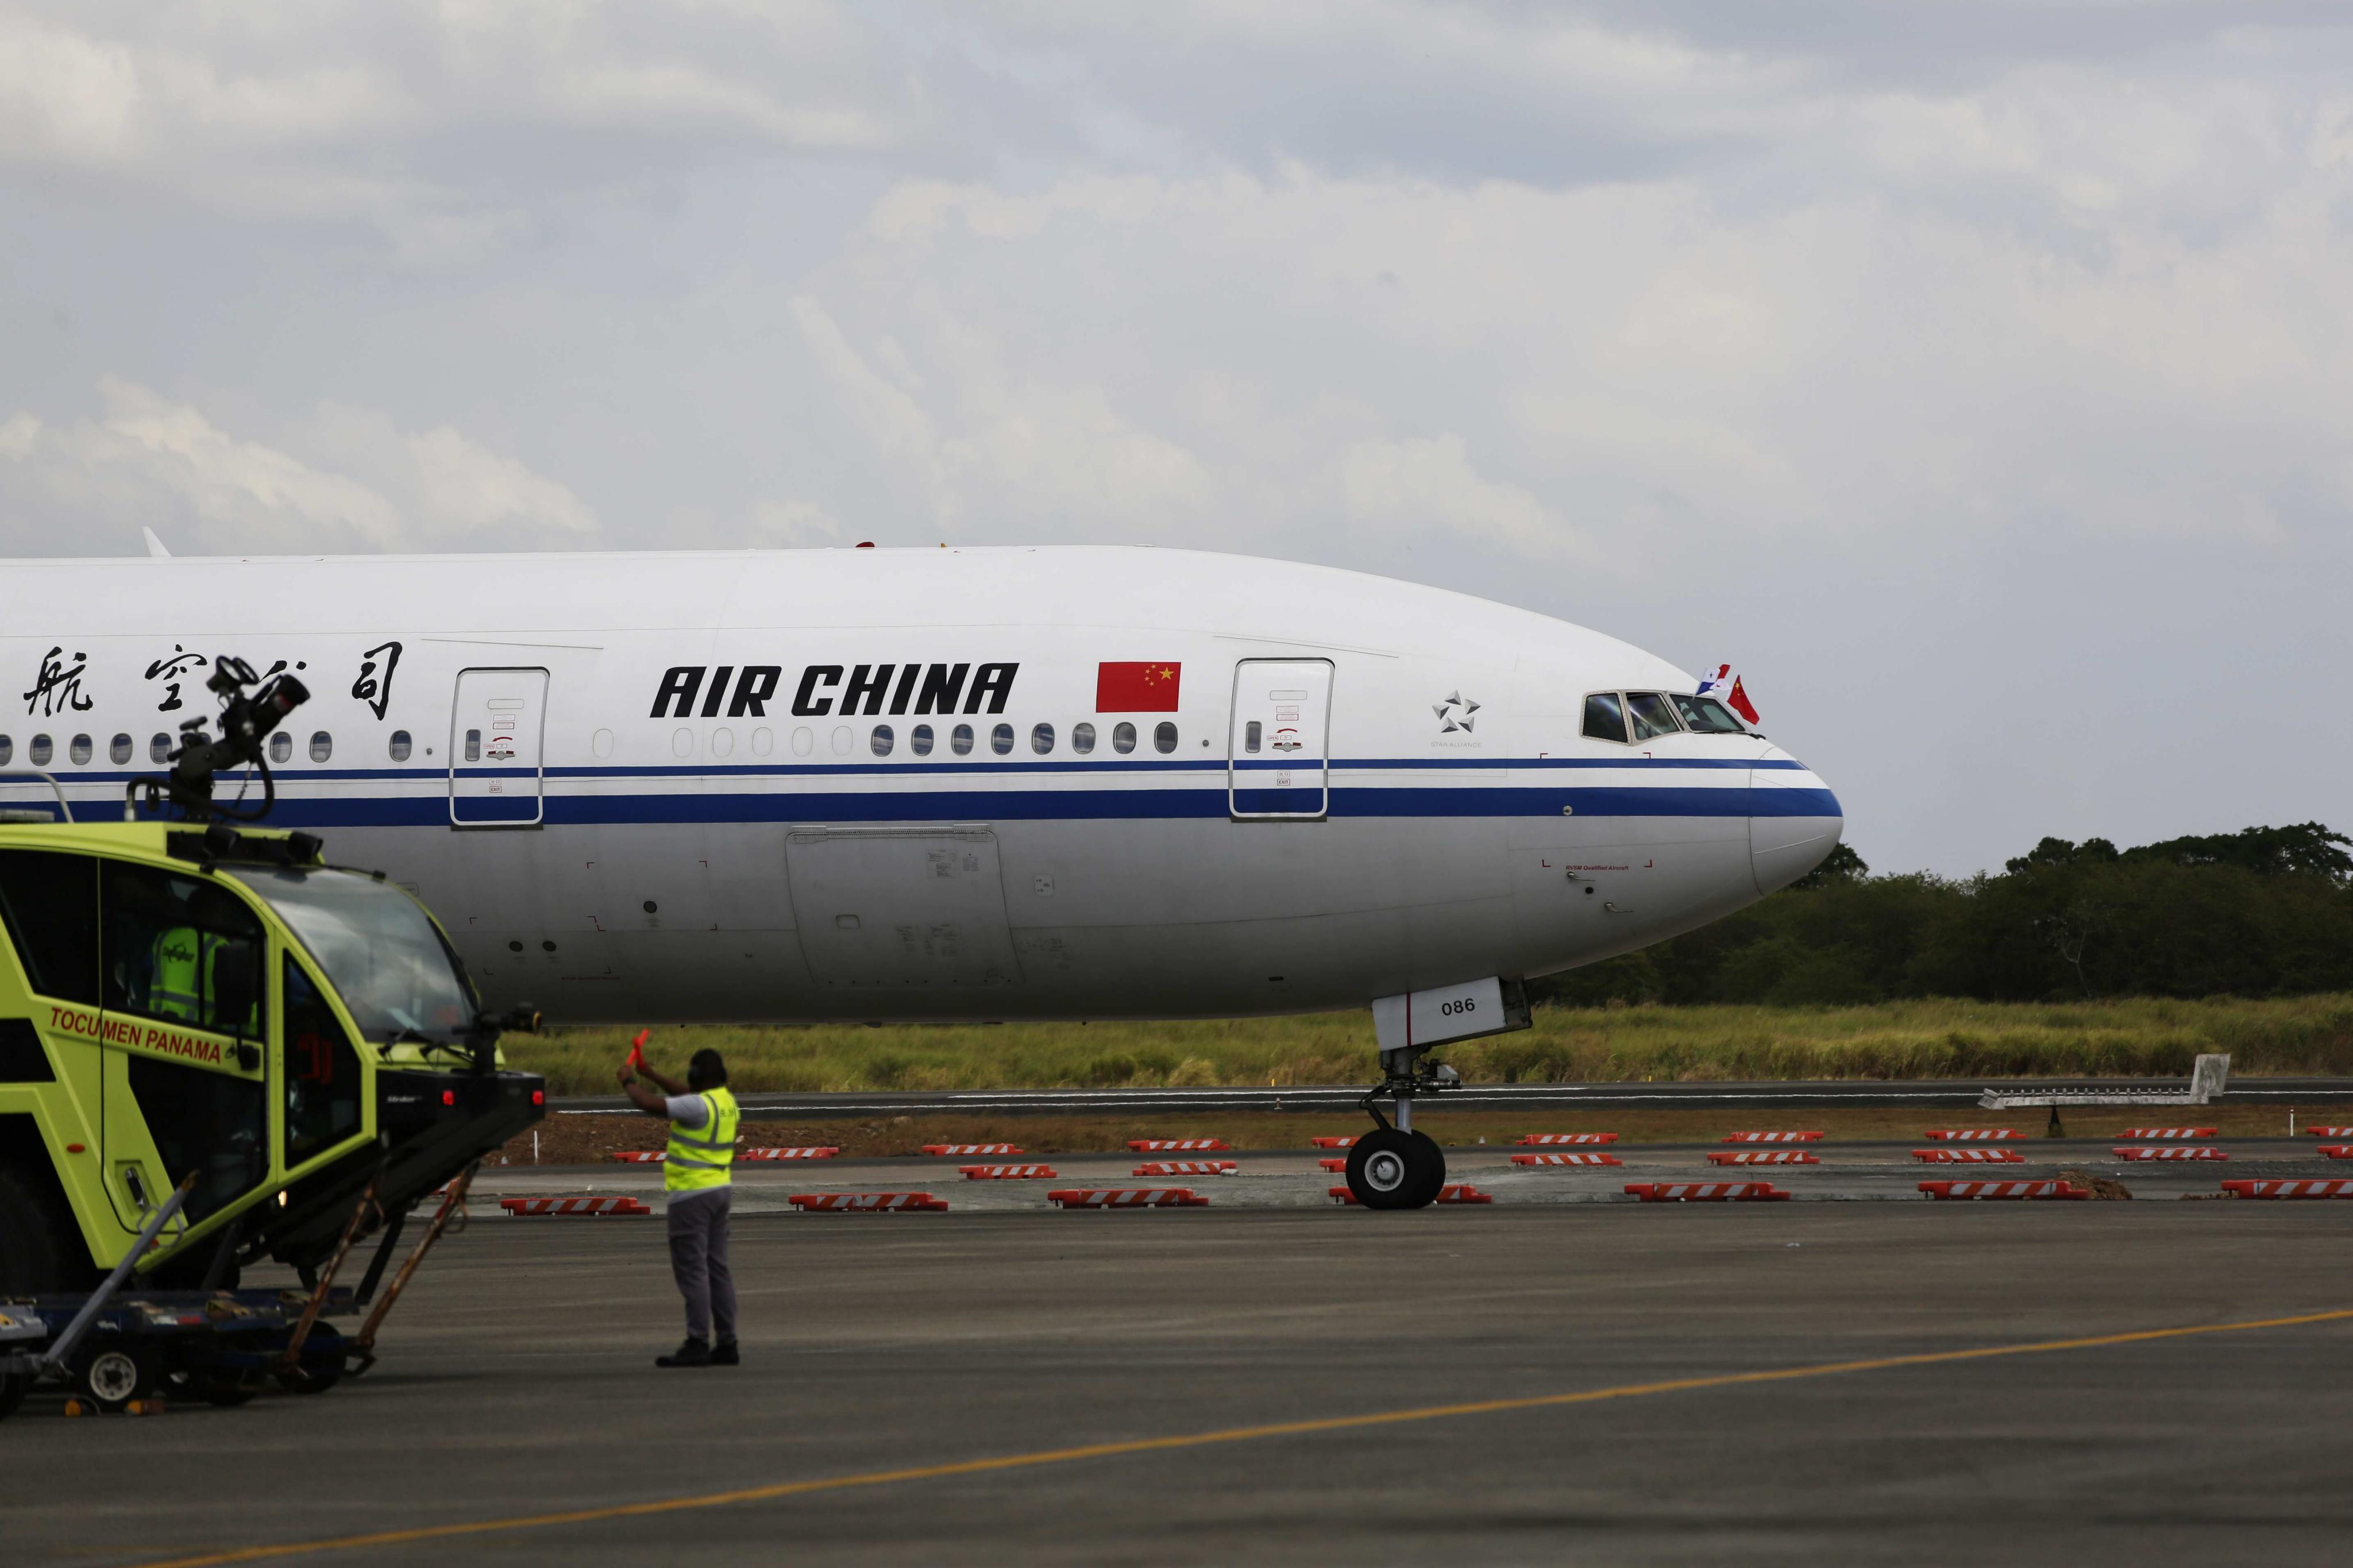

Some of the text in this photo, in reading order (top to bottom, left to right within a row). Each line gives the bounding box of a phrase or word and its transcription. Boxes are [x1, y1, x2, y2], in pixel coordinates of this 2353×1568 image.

[650, 663, 1020, 718] AIR CHINA
[1441, 998, 1475, 1016] 086
[51, 1007, 221, 1064] TOCUMEN PANAMA
